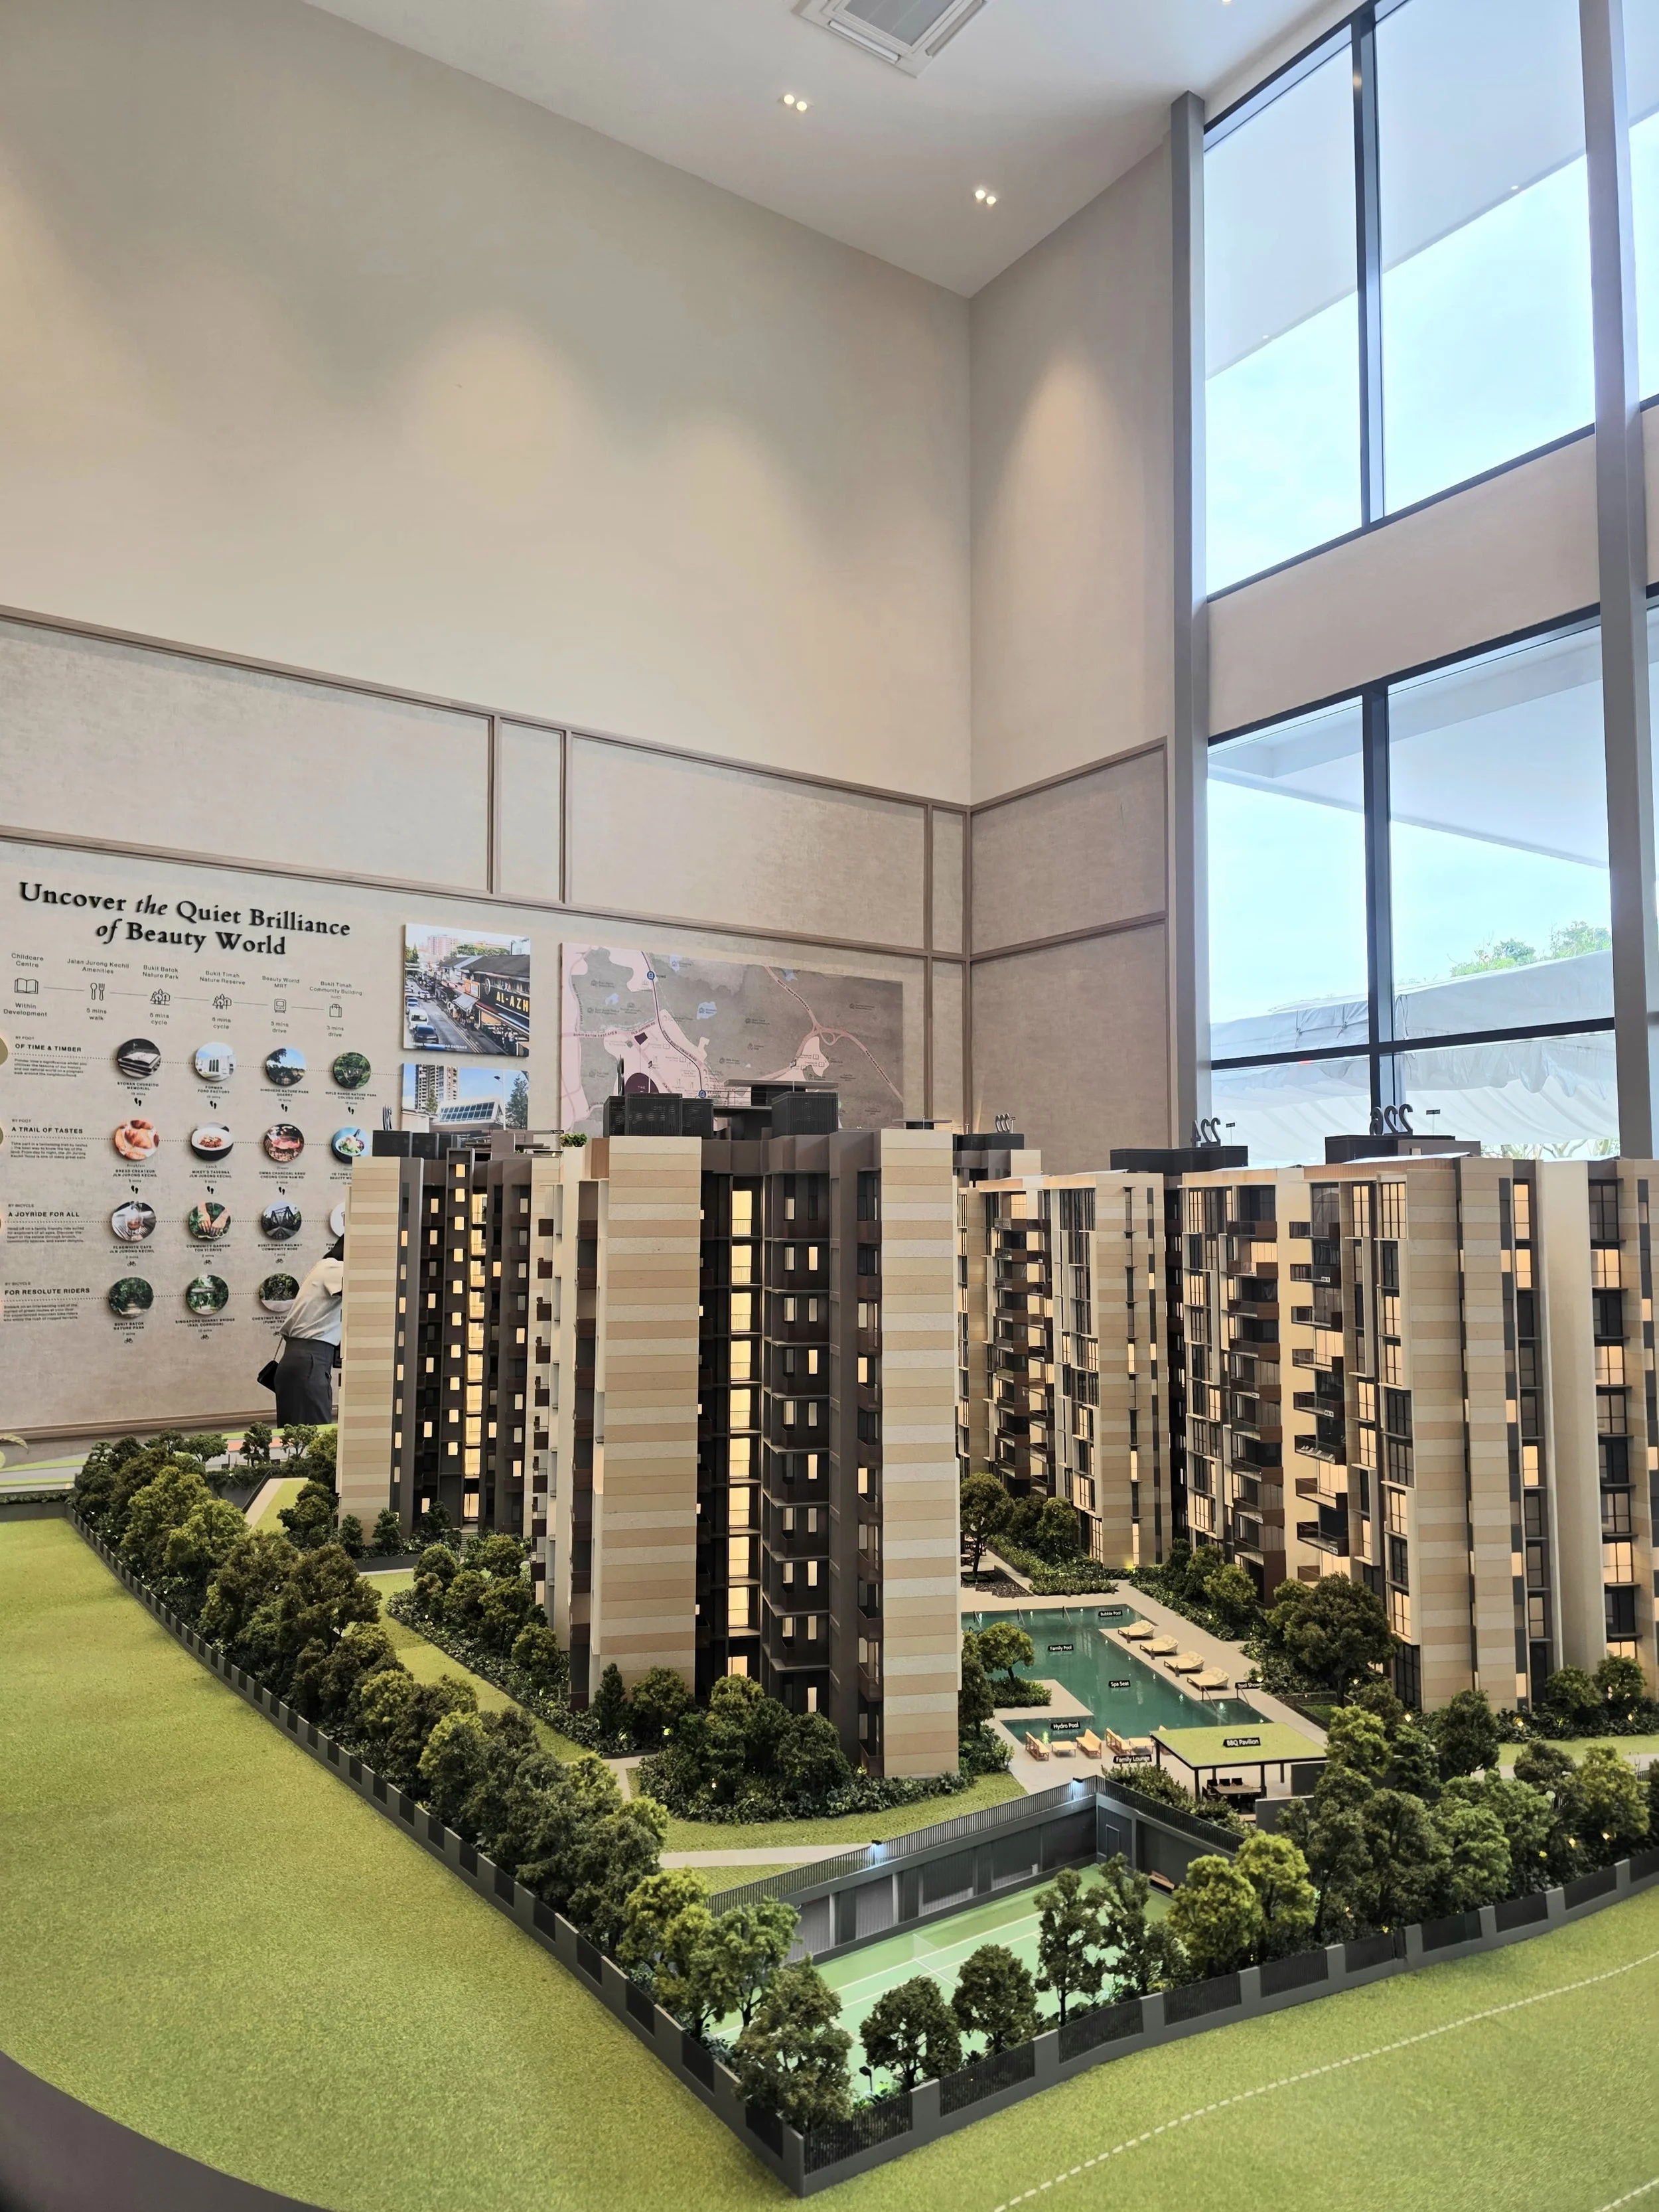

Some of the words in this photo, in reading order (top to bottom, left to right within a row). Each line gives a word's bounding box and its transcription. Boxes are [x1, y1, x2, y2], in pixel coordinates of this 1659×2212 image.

[19, 882, 127, 911] Uncover
[135, 895, 168, 916] the
[177, 901, 241, 924] Quiet
[250, 909, 350, 936] Brilliance
[96, 919, 122, 944] of
[126, 922, 206, 952] Beauty
[215, 932, 286, 955] World
[11, 952, 44, 961] Childcare
[496, 991, 529, 1012] AL-AZH
